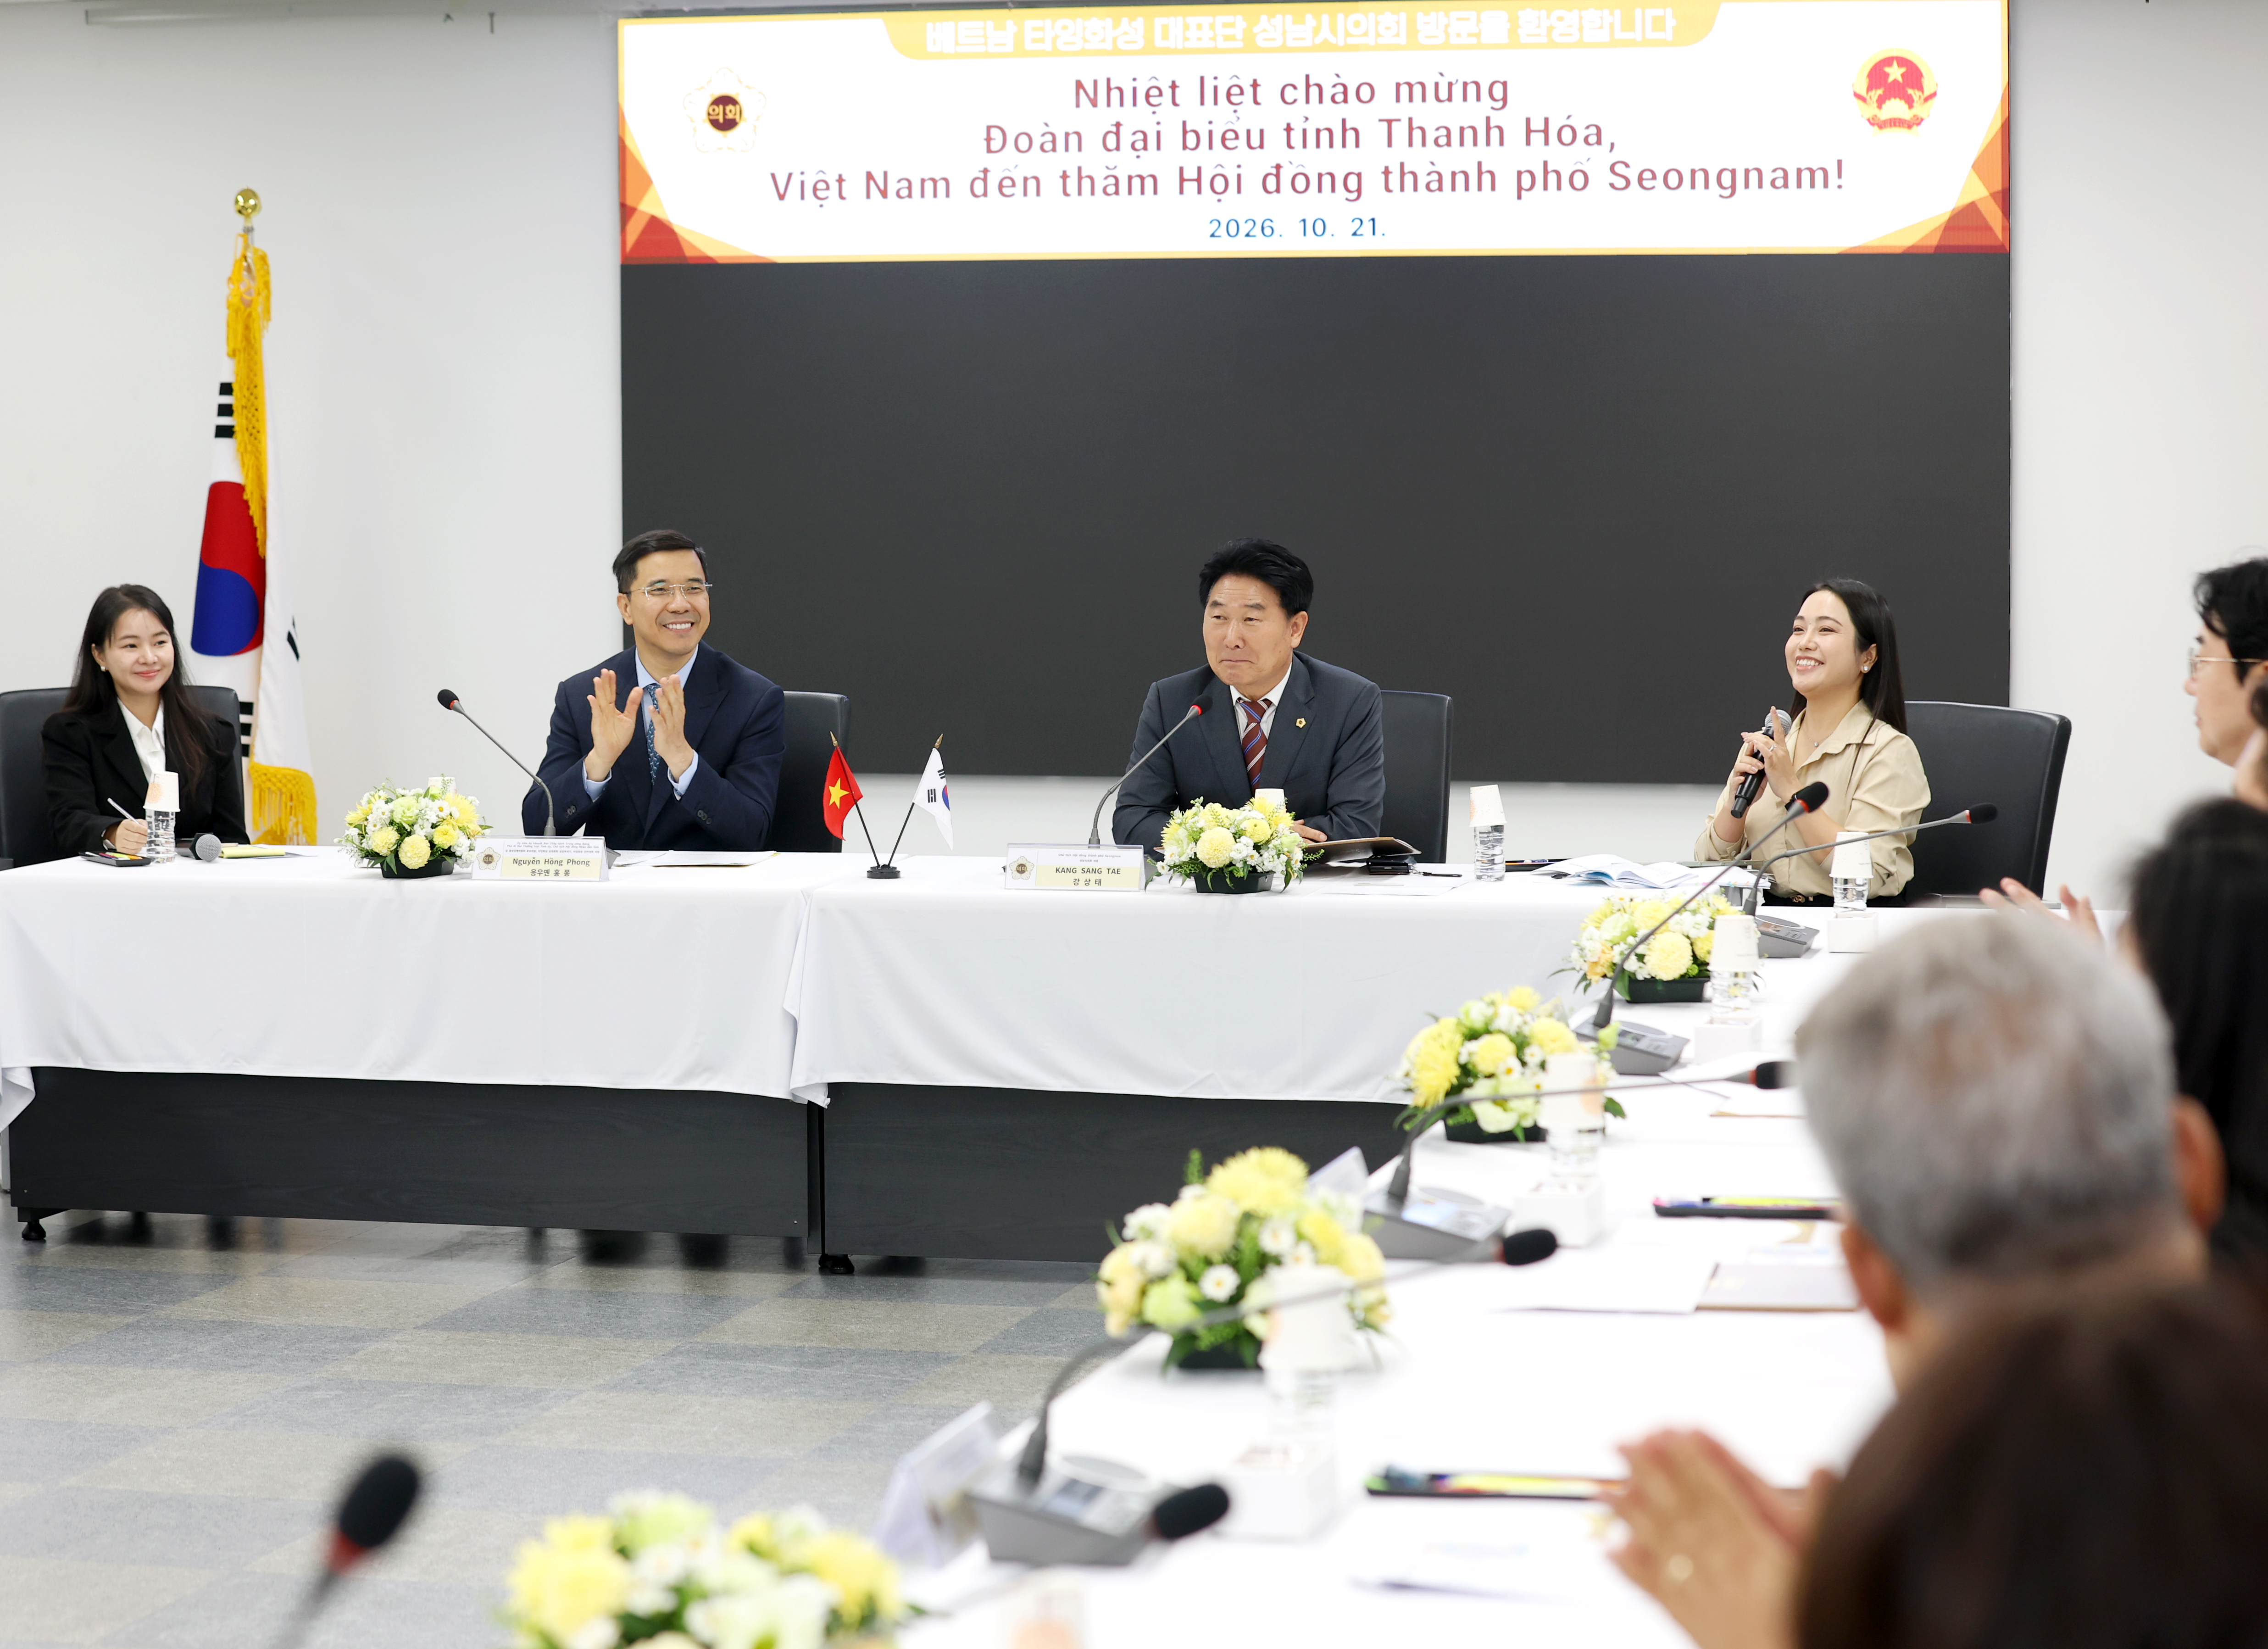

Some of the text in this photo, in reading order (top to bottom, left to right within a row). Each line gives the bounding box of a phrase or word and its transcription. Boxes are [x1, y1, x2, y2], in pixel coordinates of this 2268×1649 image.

[927, 7, 1677, 53] 베트남 타잉화성 대표단 성남시의회 방문을 환영합니다
[708, 104, 740, 123] 의회
[1075, 72, 1508, 115] Nhiệt liệt chào mừng
[983, 115, 1615, 157] Đoàn đại biểu tỉnh Thanh Hóa,
[770, 157, 1843, 207] Việt Nam đến thăm Hội đồng thành phố Seongnam!
[1209, 217, 1385, 238] 2026. 10. 21.
[512, 857, 540, 866] Nguyễn
[544, 857, 563, 866] Hồng
